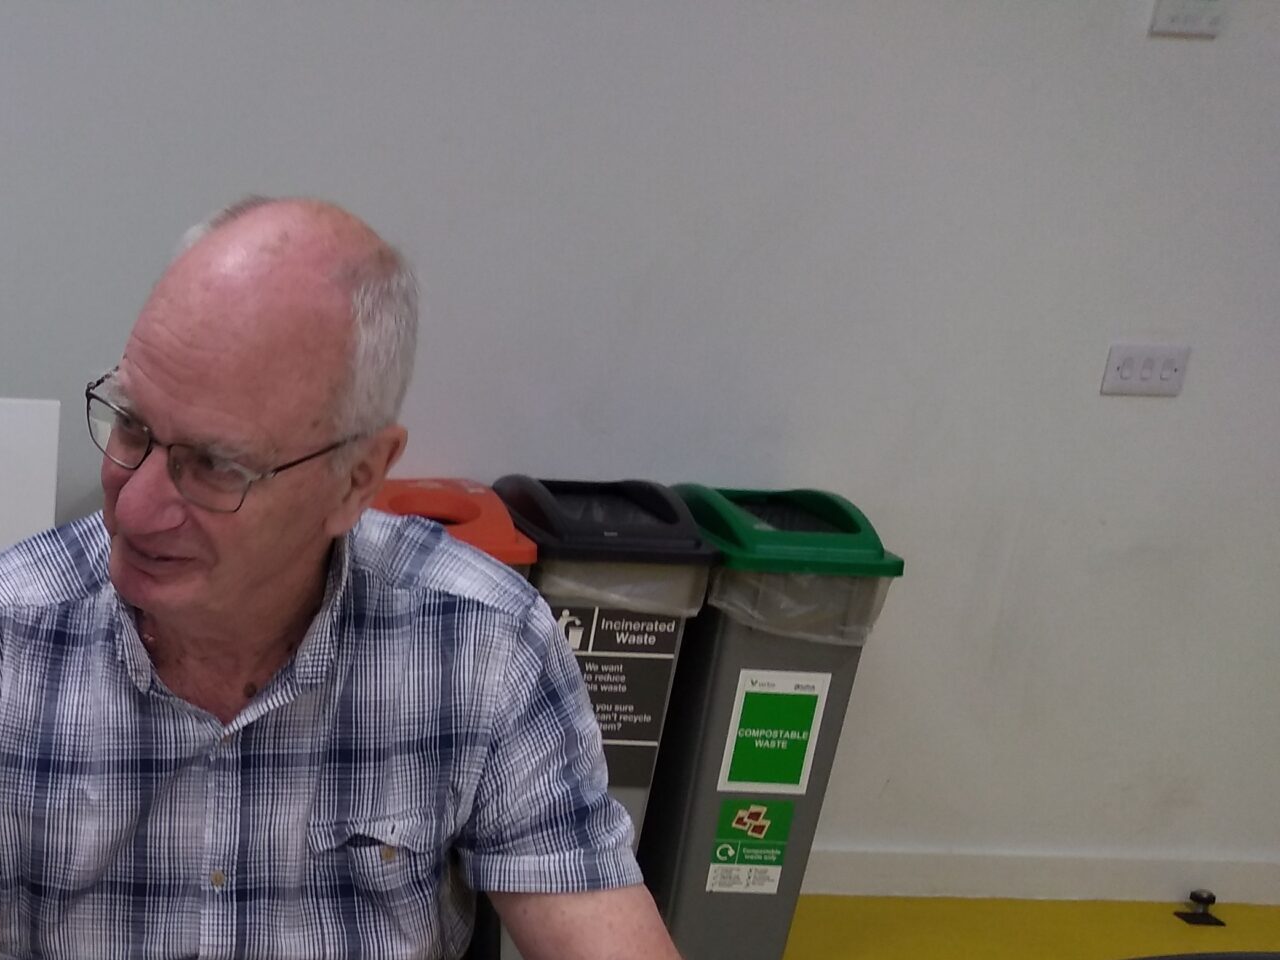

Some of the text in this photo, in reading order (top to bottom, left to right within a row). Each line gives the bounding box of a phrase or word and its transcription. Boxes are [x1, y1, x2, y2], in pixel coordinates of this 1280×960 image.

[601, 618, 676, 633] Incinerated
[615, 631, 657, 646] Waste
[585, 661, 623, 673] We want
[594, 673, 626, 683] reduce
[600, 683, 627, 693] waste
[596, 703, 634, 713] you sure
[619, 713, 652, 723] recycle
[738, 727, 809, 741] COMPOSTABLE
[755, 738, 788, 750] WASTE
